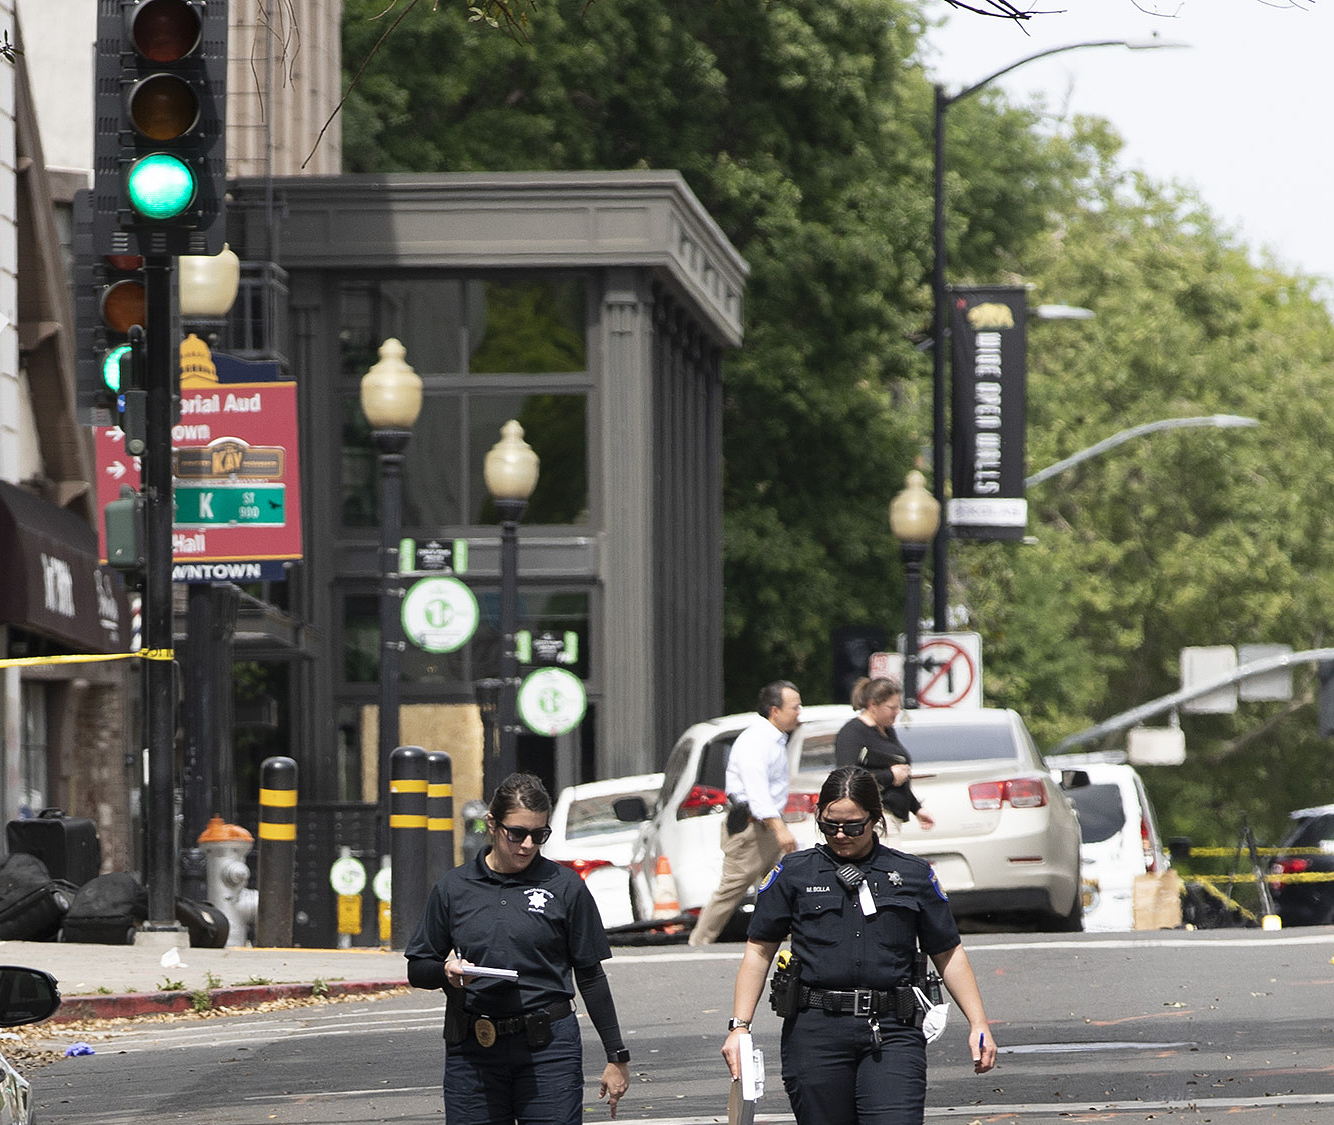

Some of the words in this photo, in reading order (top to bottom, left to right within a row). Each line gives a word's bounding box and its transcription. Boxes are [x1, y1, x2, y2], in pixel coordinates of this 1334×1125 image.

[223, 393, 262, 413] Aud
[974, 381, 1002, 429] OPEN
[199, 492, 214, 519] K
[172, 533, 206, 553] Hall
